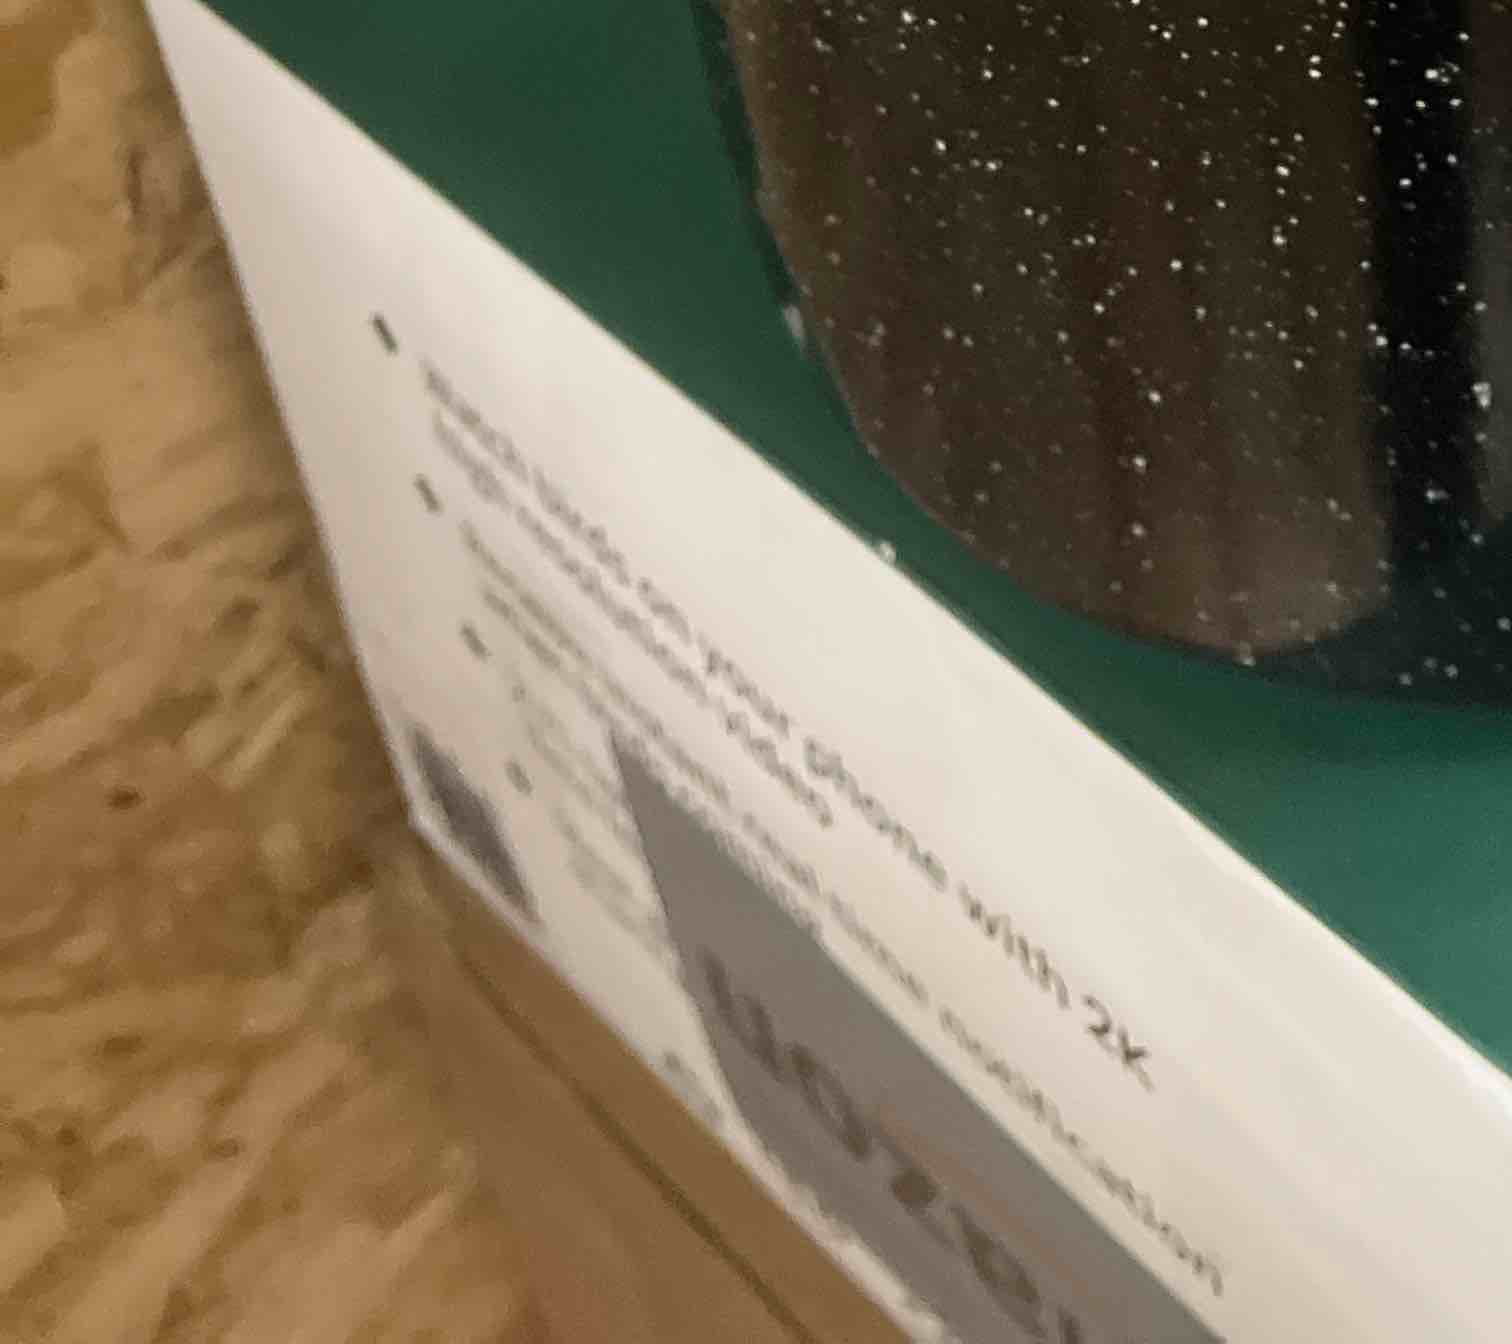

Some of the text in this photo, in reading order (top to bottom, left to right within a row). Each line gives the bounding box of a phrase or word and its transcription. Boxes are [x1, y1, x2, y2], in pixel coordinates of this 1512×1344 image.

[697, 630, 790, 740] your
[802, 736, 947, 892] phone
[957, 882, 1070, 1010] with
[1082, 994, 1156, 1094] 2K
[938, 1004, 1224, 1298] notification
